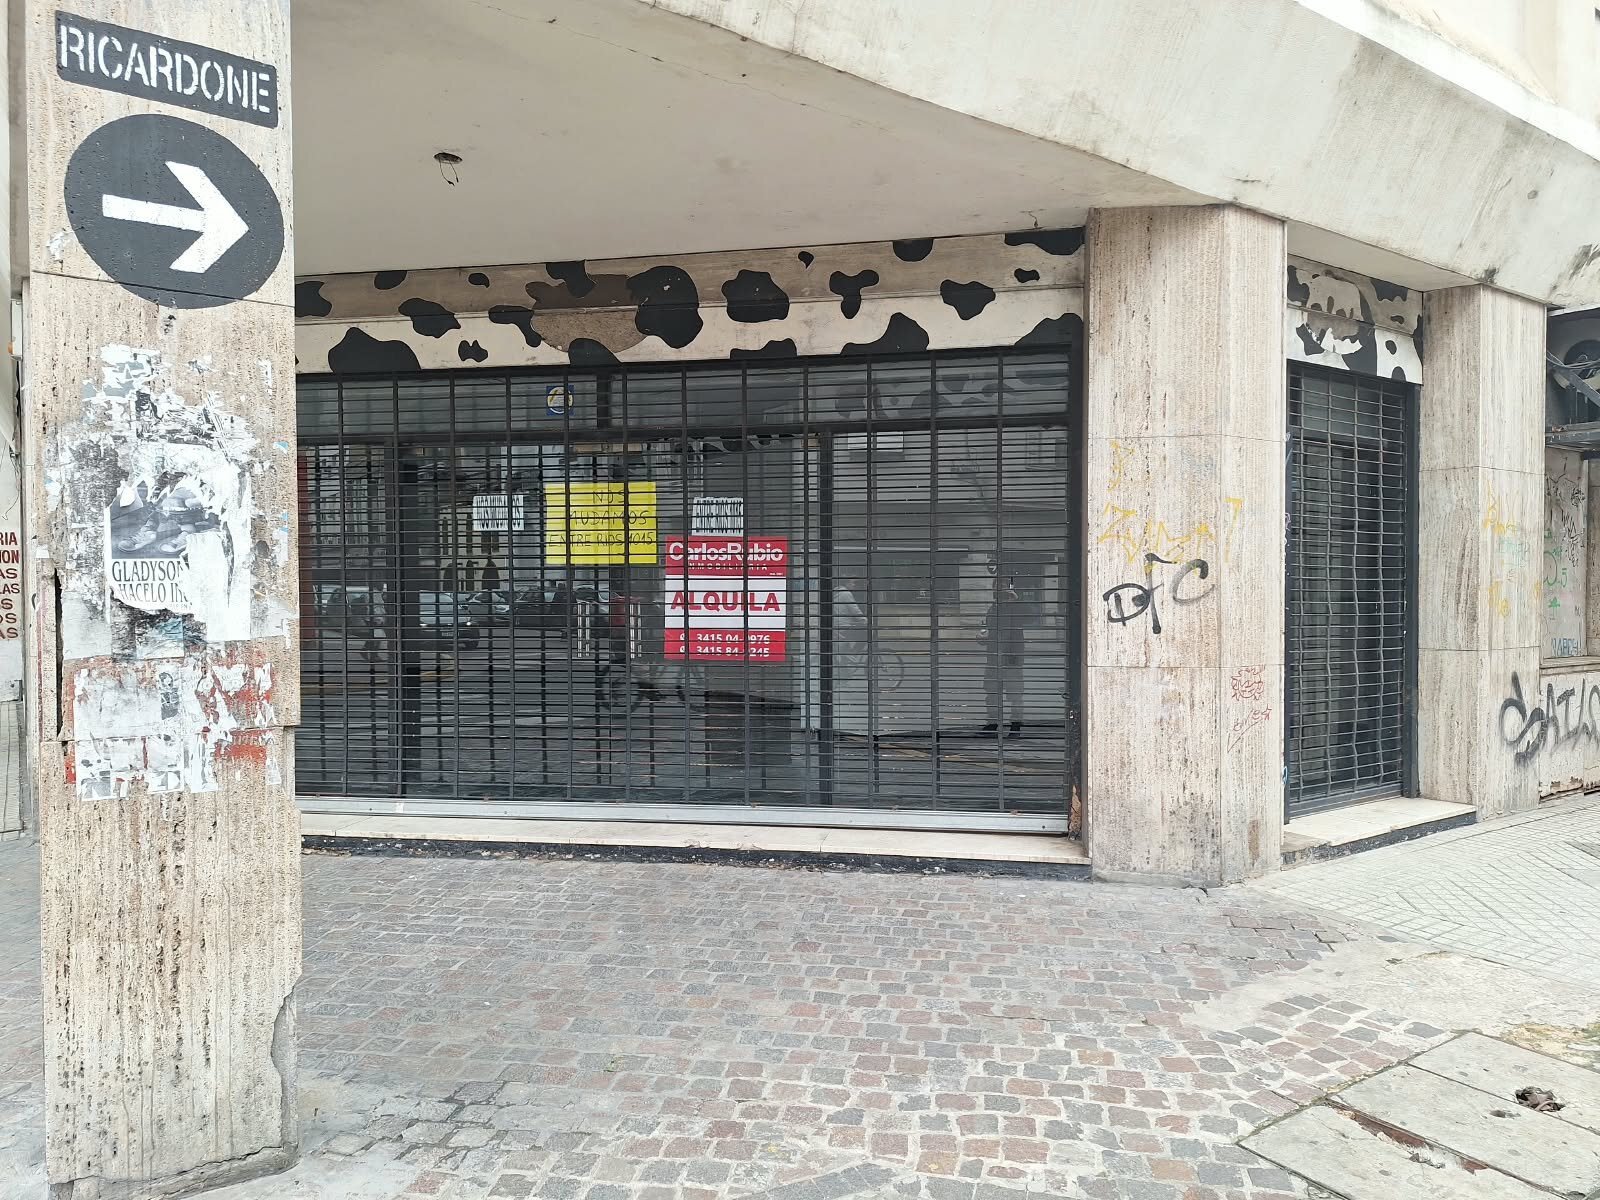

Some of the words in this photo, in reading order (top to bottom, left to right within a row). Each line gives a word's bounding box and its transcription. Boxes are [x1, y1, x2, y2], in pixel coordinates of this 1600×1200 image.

[60, 24, 271, 114] RICARDONE
[592, 489, 625, 504] NOS
[669, 542, 783, 560] CarlosRubio
[686, 562, 768, 571] NMOBILIRIA
[670, 591, 780, 612] ALQUILA
[697, 633, 722, 644] 3415
[726, 634, 770, 644] 04-976
[696, 646, 722, 656] 3415
[726, 646, 770, 657] 84-245
